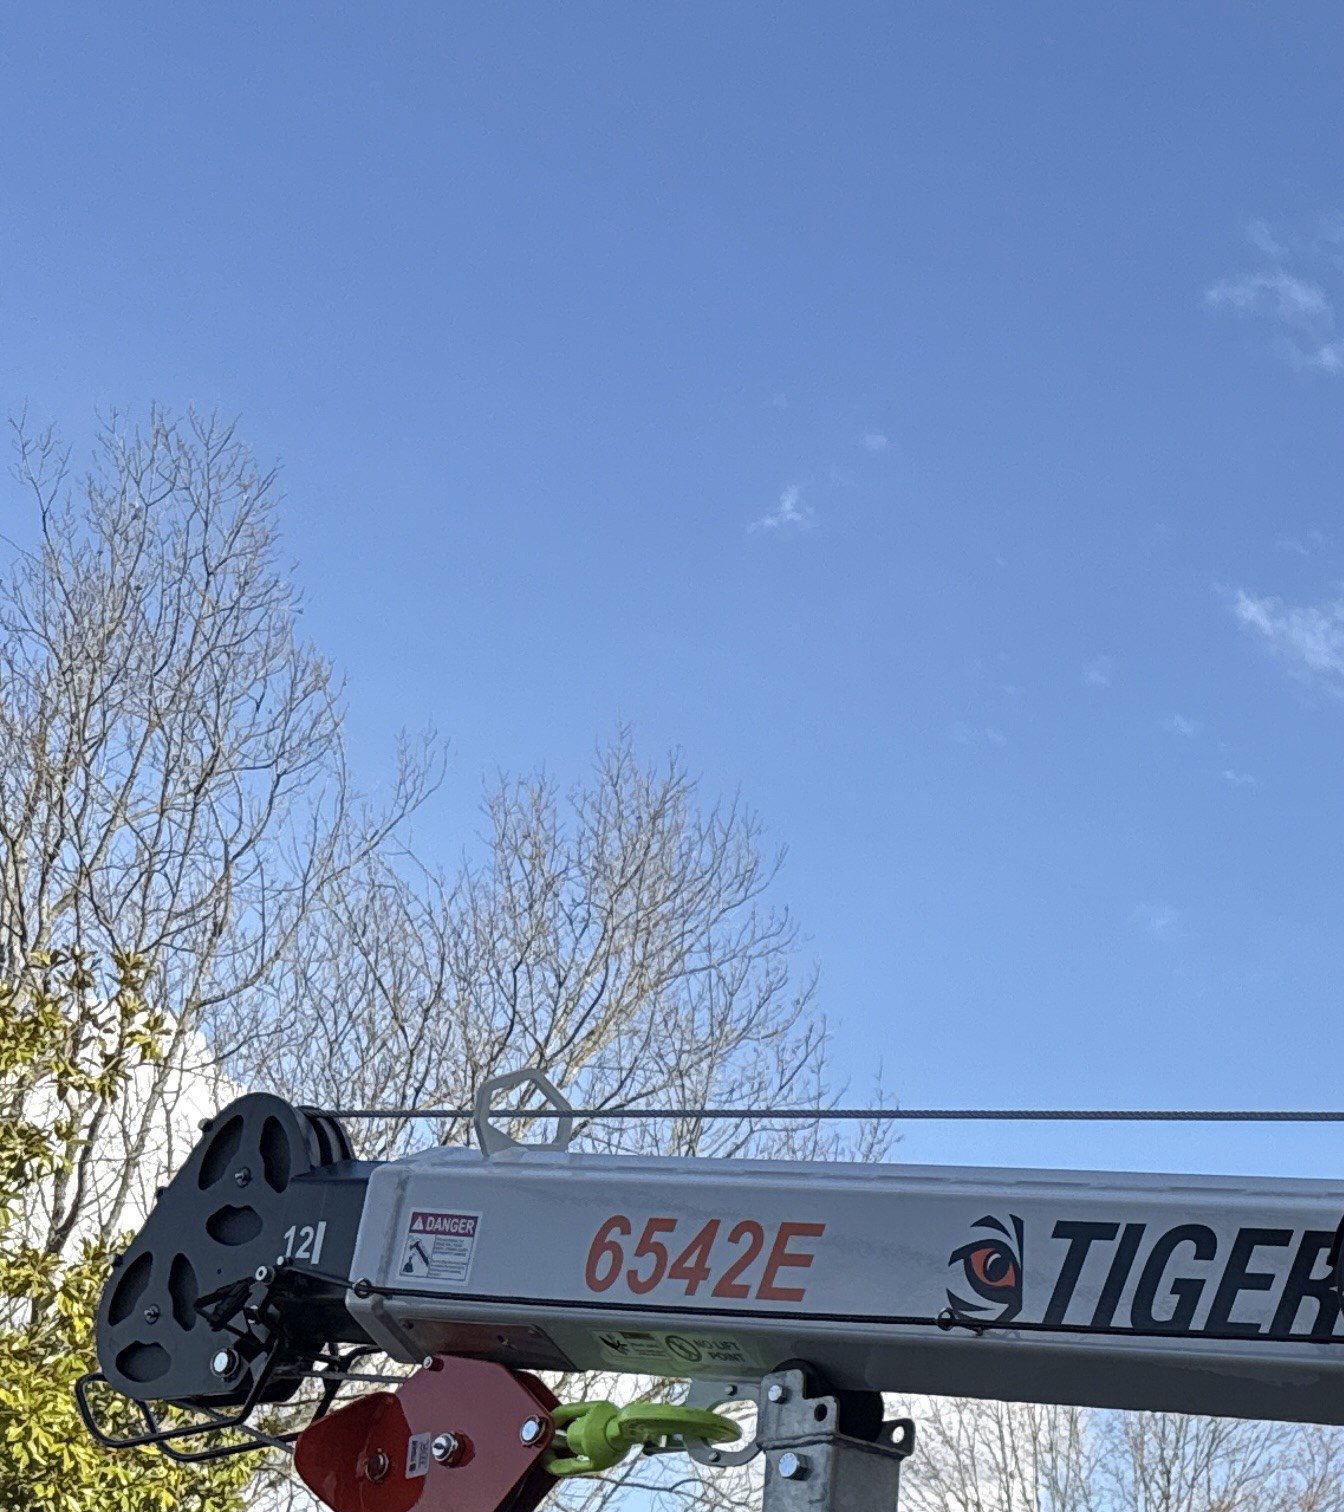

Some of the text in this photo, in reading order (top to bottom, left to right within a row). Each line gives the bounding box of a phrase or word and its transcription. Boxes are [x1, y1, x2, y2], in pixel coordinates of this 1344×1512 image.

[425, 1216, 475, 1235] DANGER
[585, 1215, 826, 1302] 6542E
[1041, 1220, 1343, 1337] TIGER
